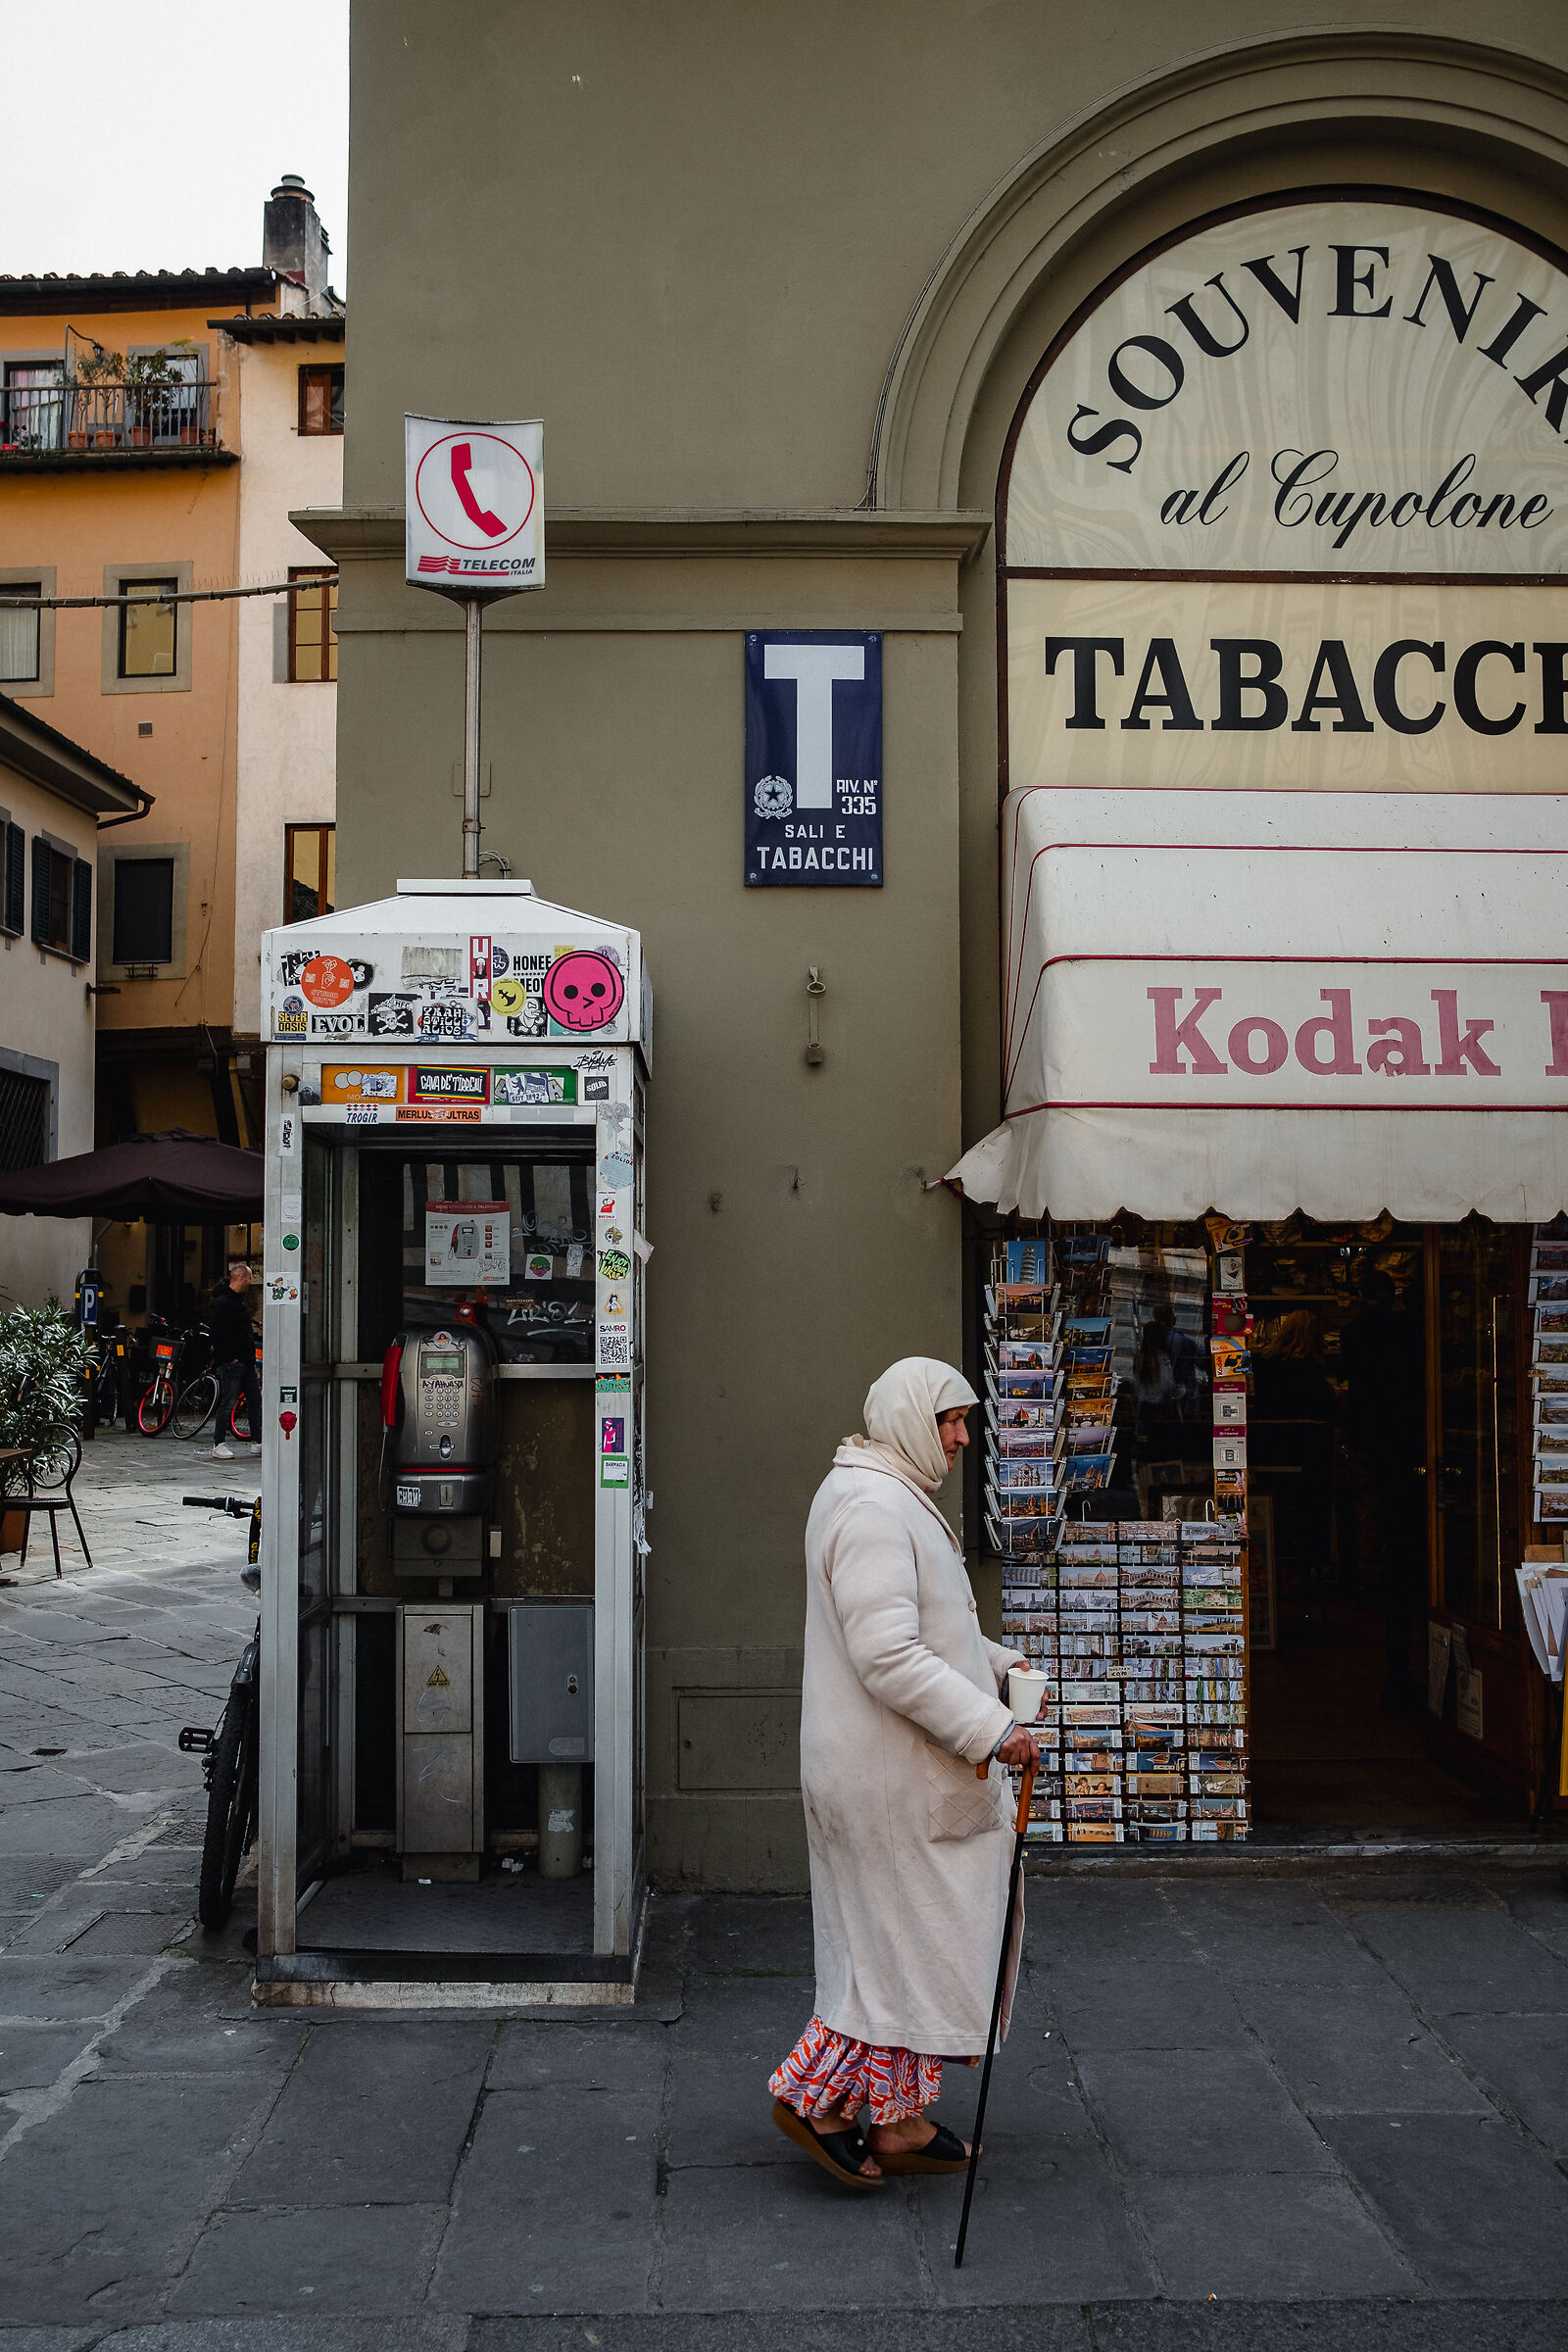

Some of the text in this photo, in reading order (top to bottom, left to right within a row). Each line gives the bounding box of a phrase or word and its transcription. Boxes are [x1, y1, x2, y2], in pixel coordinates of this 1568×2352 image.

[1160, 448, 1554, 550] al Cupolone
[463, 558, 536, 570] TELECOM
[763, 644, 864, 809] T
[836, 779, 860, 794] RIV.
[841, 796, 877, 815] 335
[785, 824, 846, 839] SALI E
[757, 846, 873, 870] TABACCHI
[278, 1022, 307, 1032] OASIS
[313, 1015, 365, 1033] EVOL
[1146, 987, 1502, 1077] Kodak
[346, 1112, 378, 1124] TROGIR
[446, 1110, 479, 1120] ULTRAS
[83, 1288, 95, 1319] P
[599, 1324, 626, 1333] SAMRO
